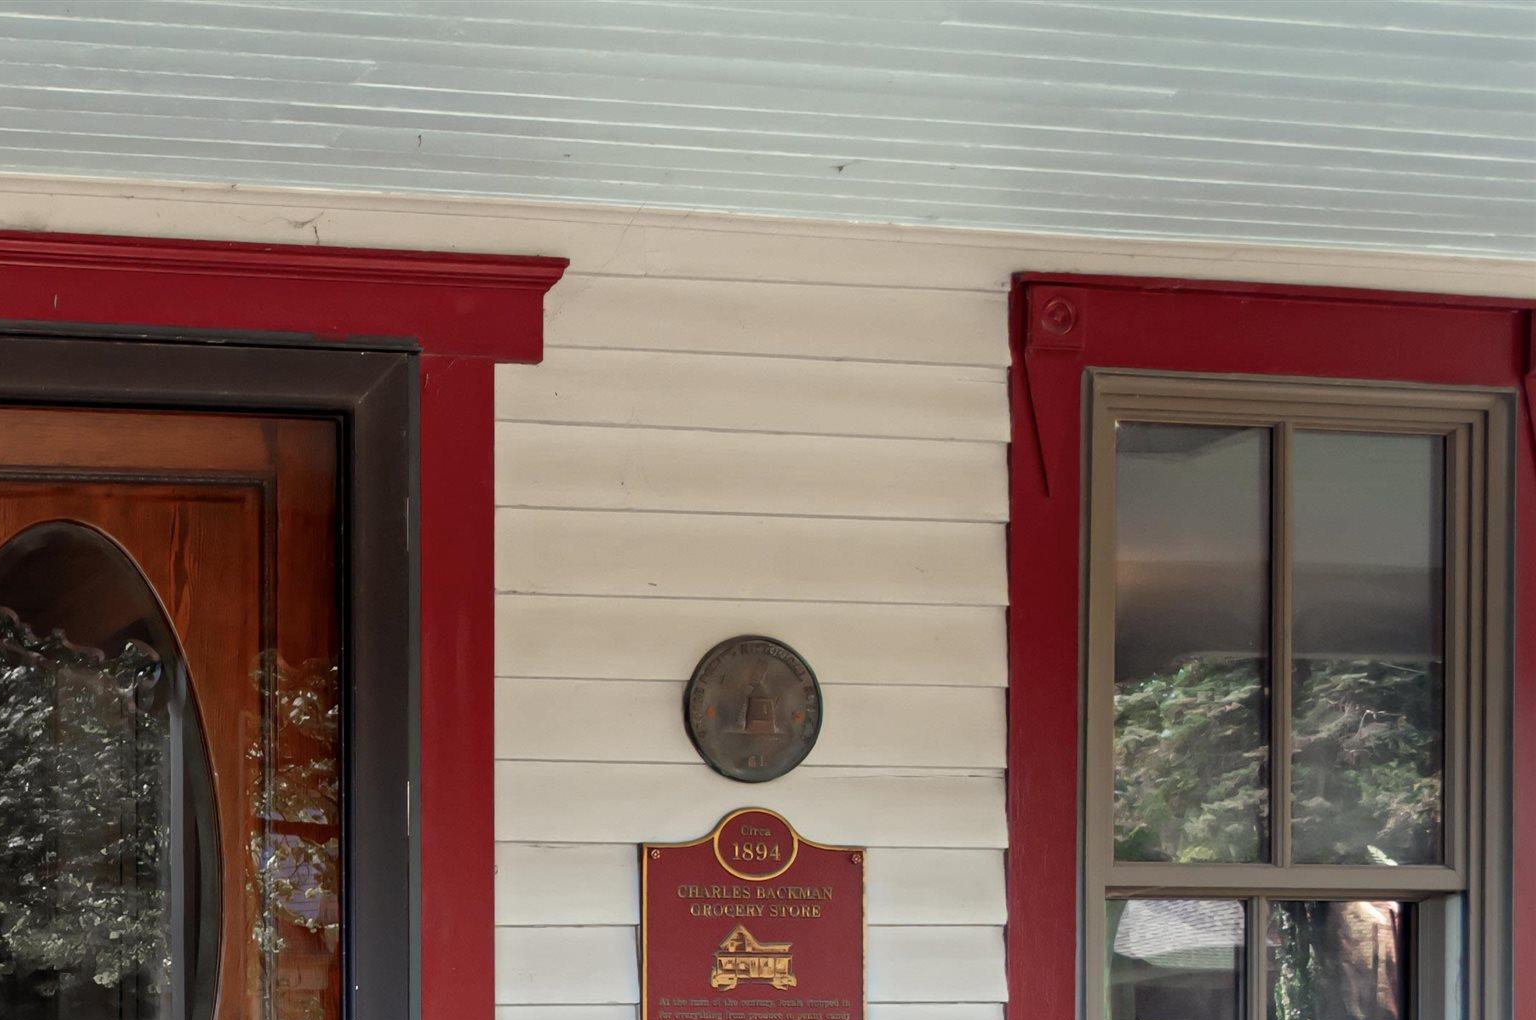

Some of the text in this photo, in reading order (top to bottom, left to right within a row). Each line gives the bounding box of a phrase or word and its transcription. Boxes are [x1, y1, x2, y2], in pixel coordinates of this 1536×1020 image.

[740, 824, 772, 837] Circa
[731, 842, 781, 861] 1894
[677, 885, 833, 900] CHARLES BACKMAN
[690, 903, 821, 918] GROCERY STORE
